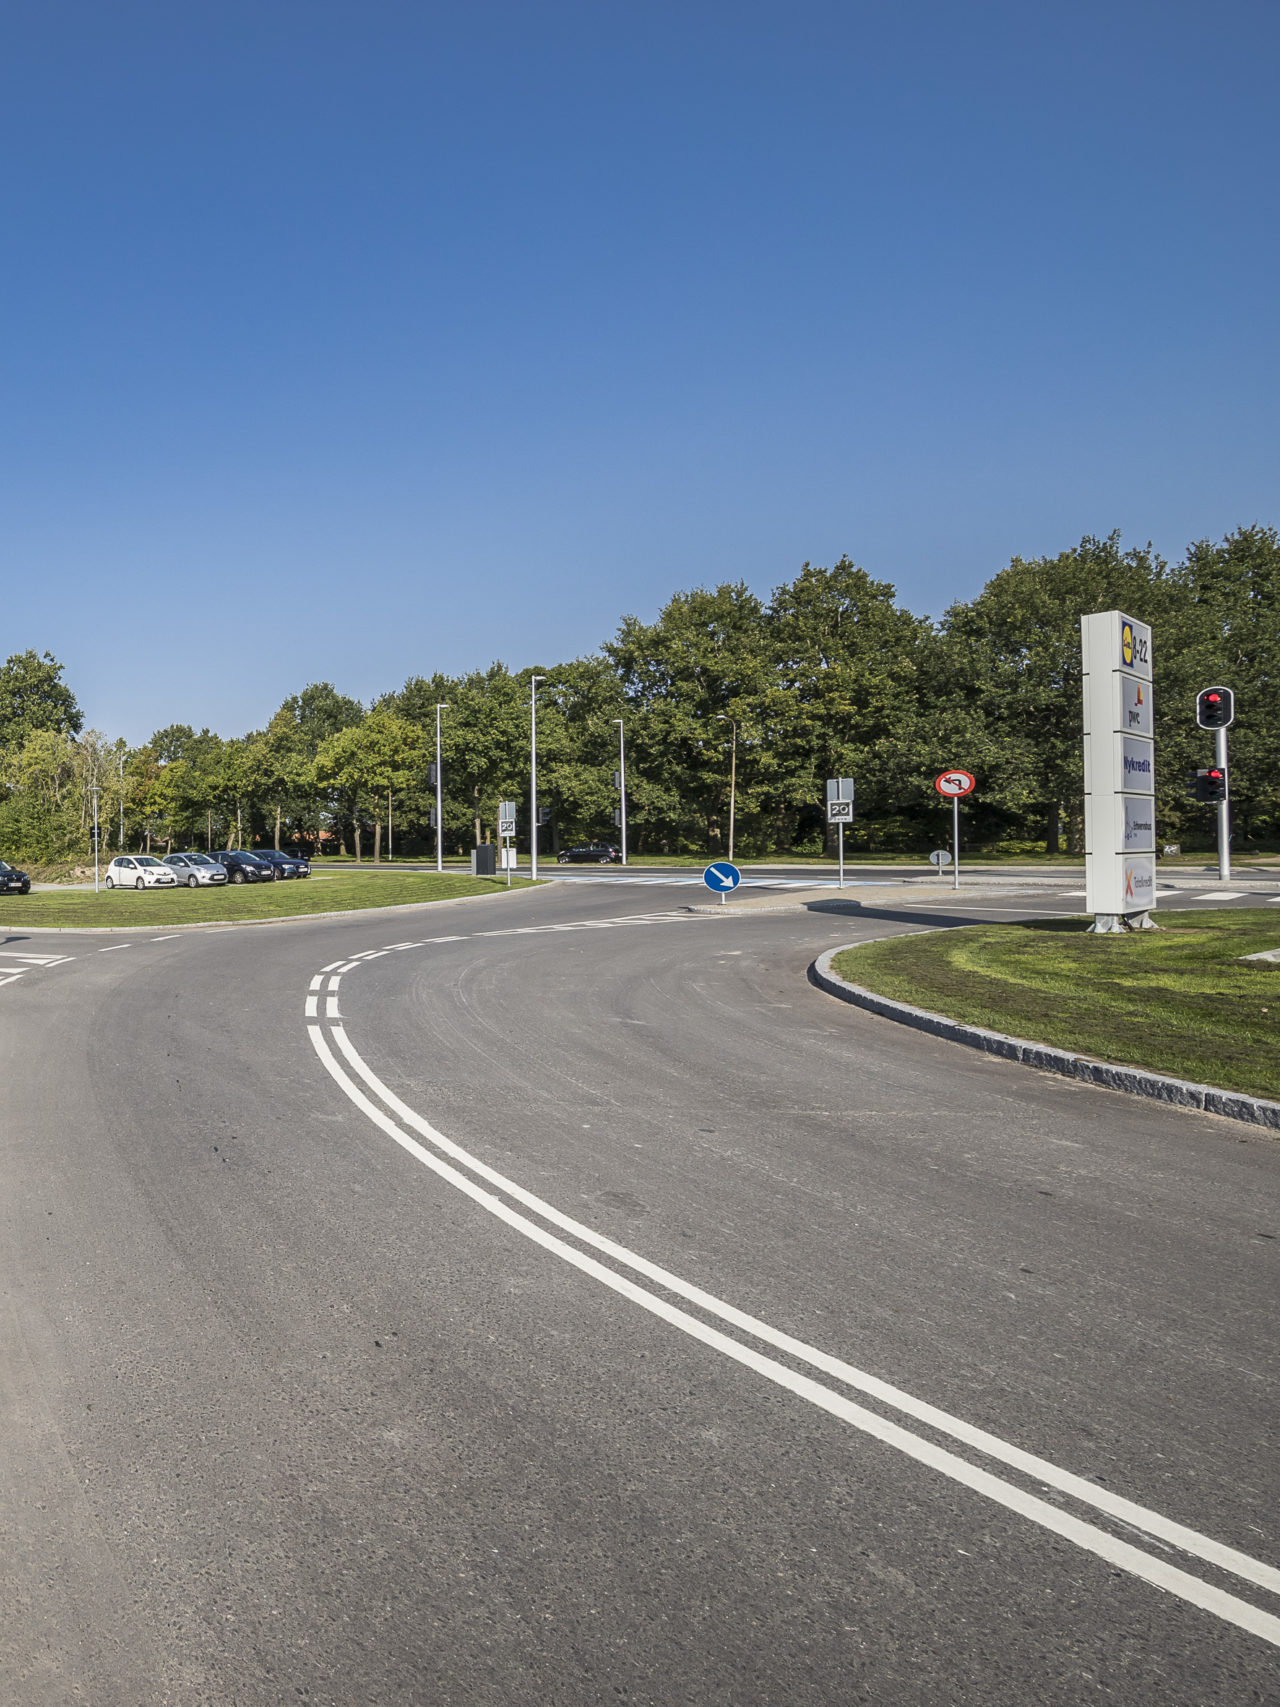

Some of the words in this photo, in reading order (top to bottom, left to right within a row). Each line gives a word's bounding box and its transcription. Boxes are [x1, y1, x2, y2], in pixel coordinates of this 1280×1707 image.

[1133, 635, 1148, 663] 8-22
[1124, 756, 1151, 773] Nykredit
[832, 805, 848, 814] 20
